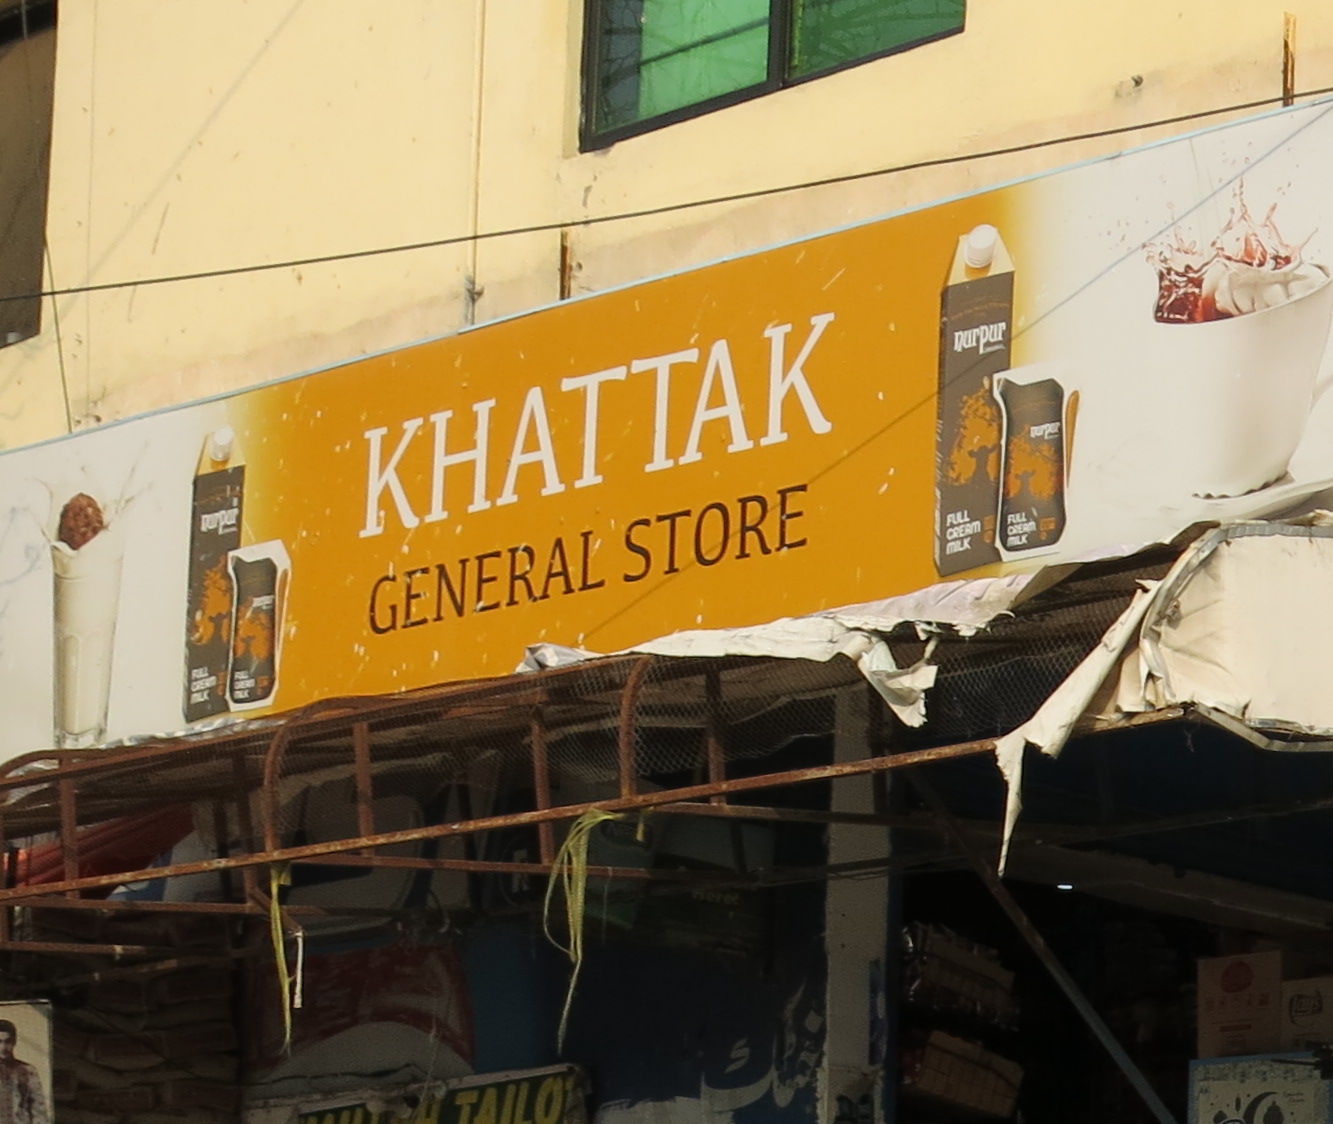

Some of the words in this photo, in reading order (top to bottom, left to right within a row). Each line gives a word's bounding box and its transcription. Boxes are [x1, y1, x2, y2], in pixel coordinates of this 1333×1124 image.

[359, 312, 834, 538] KHATTAK
[946, 509, 970, 526] FULL
[1007, 511, 1027, 524] FULL
[946, 520, 981, 540] CREAM
[946, 537, 971, 555] MILK
[1007, 534, 1027, 547] MILK
[368, 529, 605, 636] GENERAL
[622, 484, 806, 582] STORE
